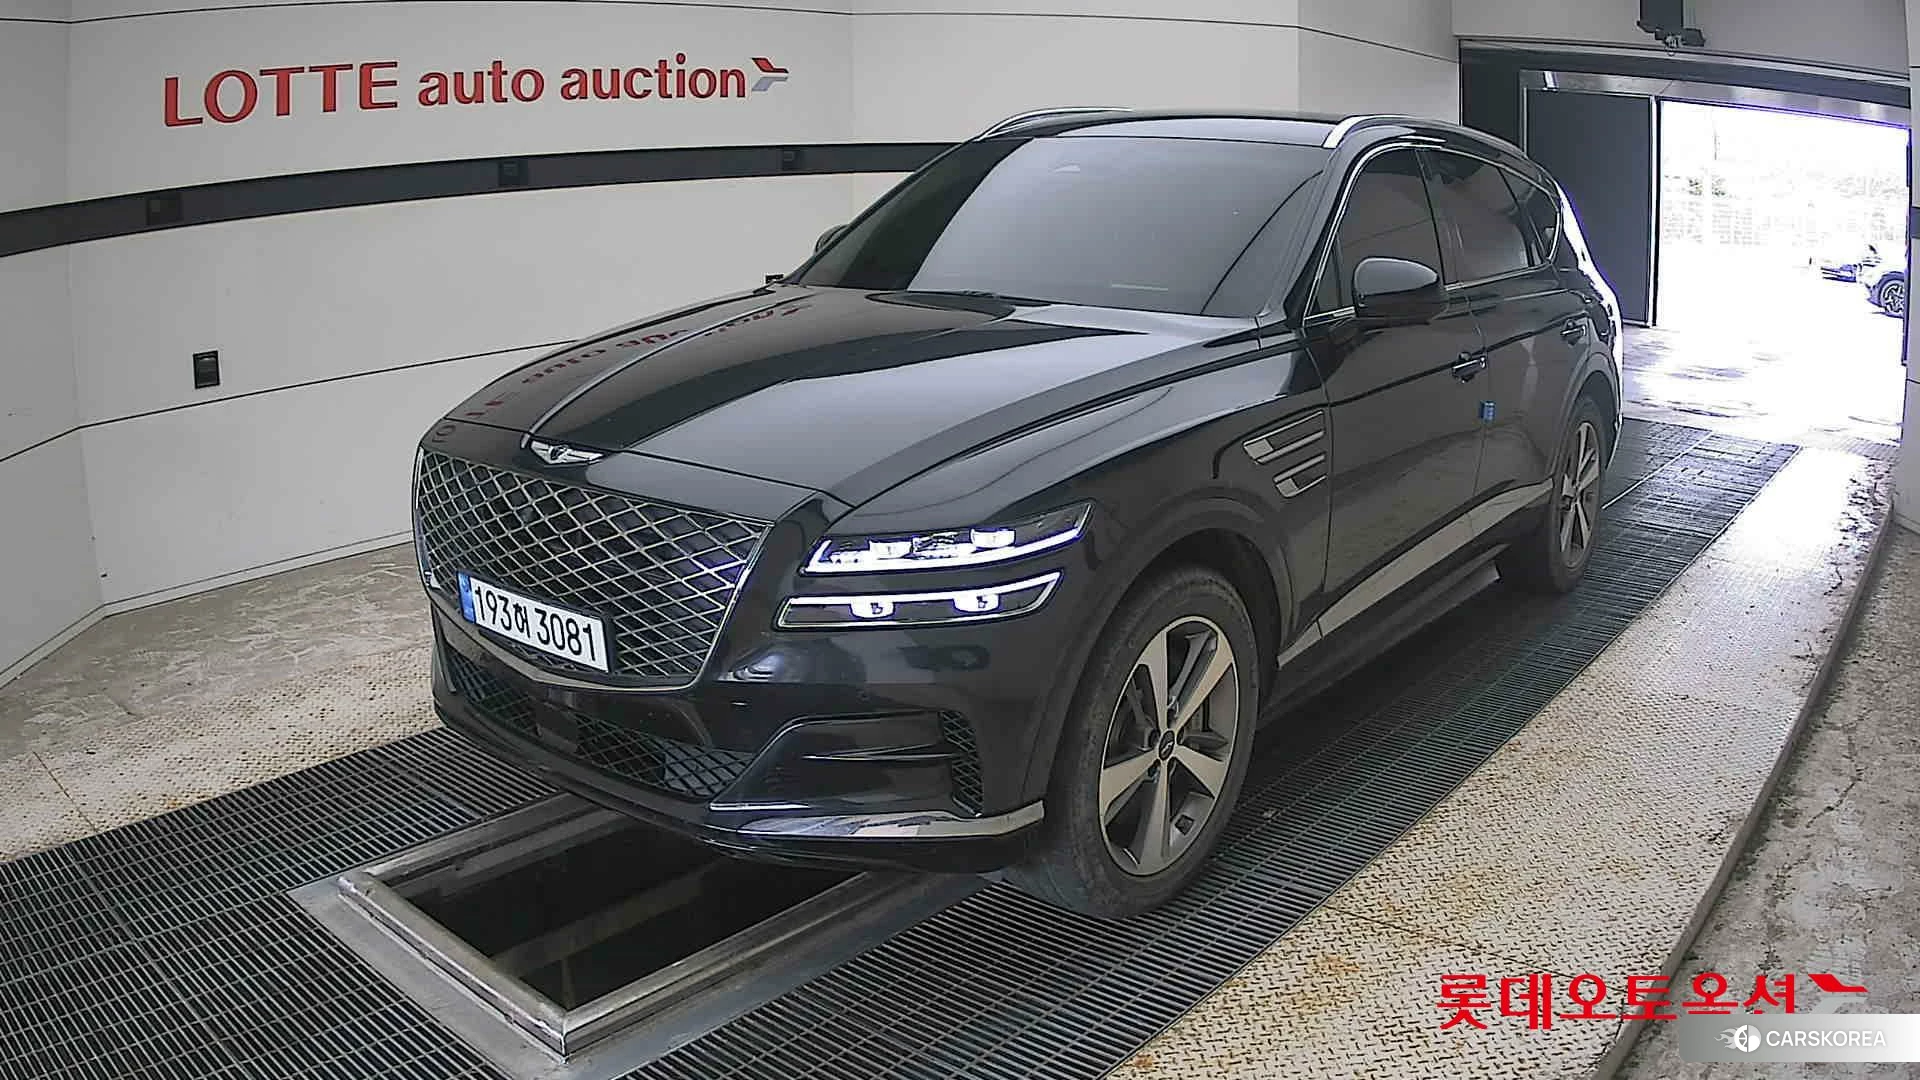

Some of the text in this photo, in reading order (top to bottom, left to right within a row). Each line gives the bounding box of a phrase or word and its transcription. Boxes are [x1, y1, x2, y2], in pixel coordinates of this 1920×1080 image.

[165, 52, 747, 127] LOTTE auto auction
[535, 608, 595, 662] 3081
